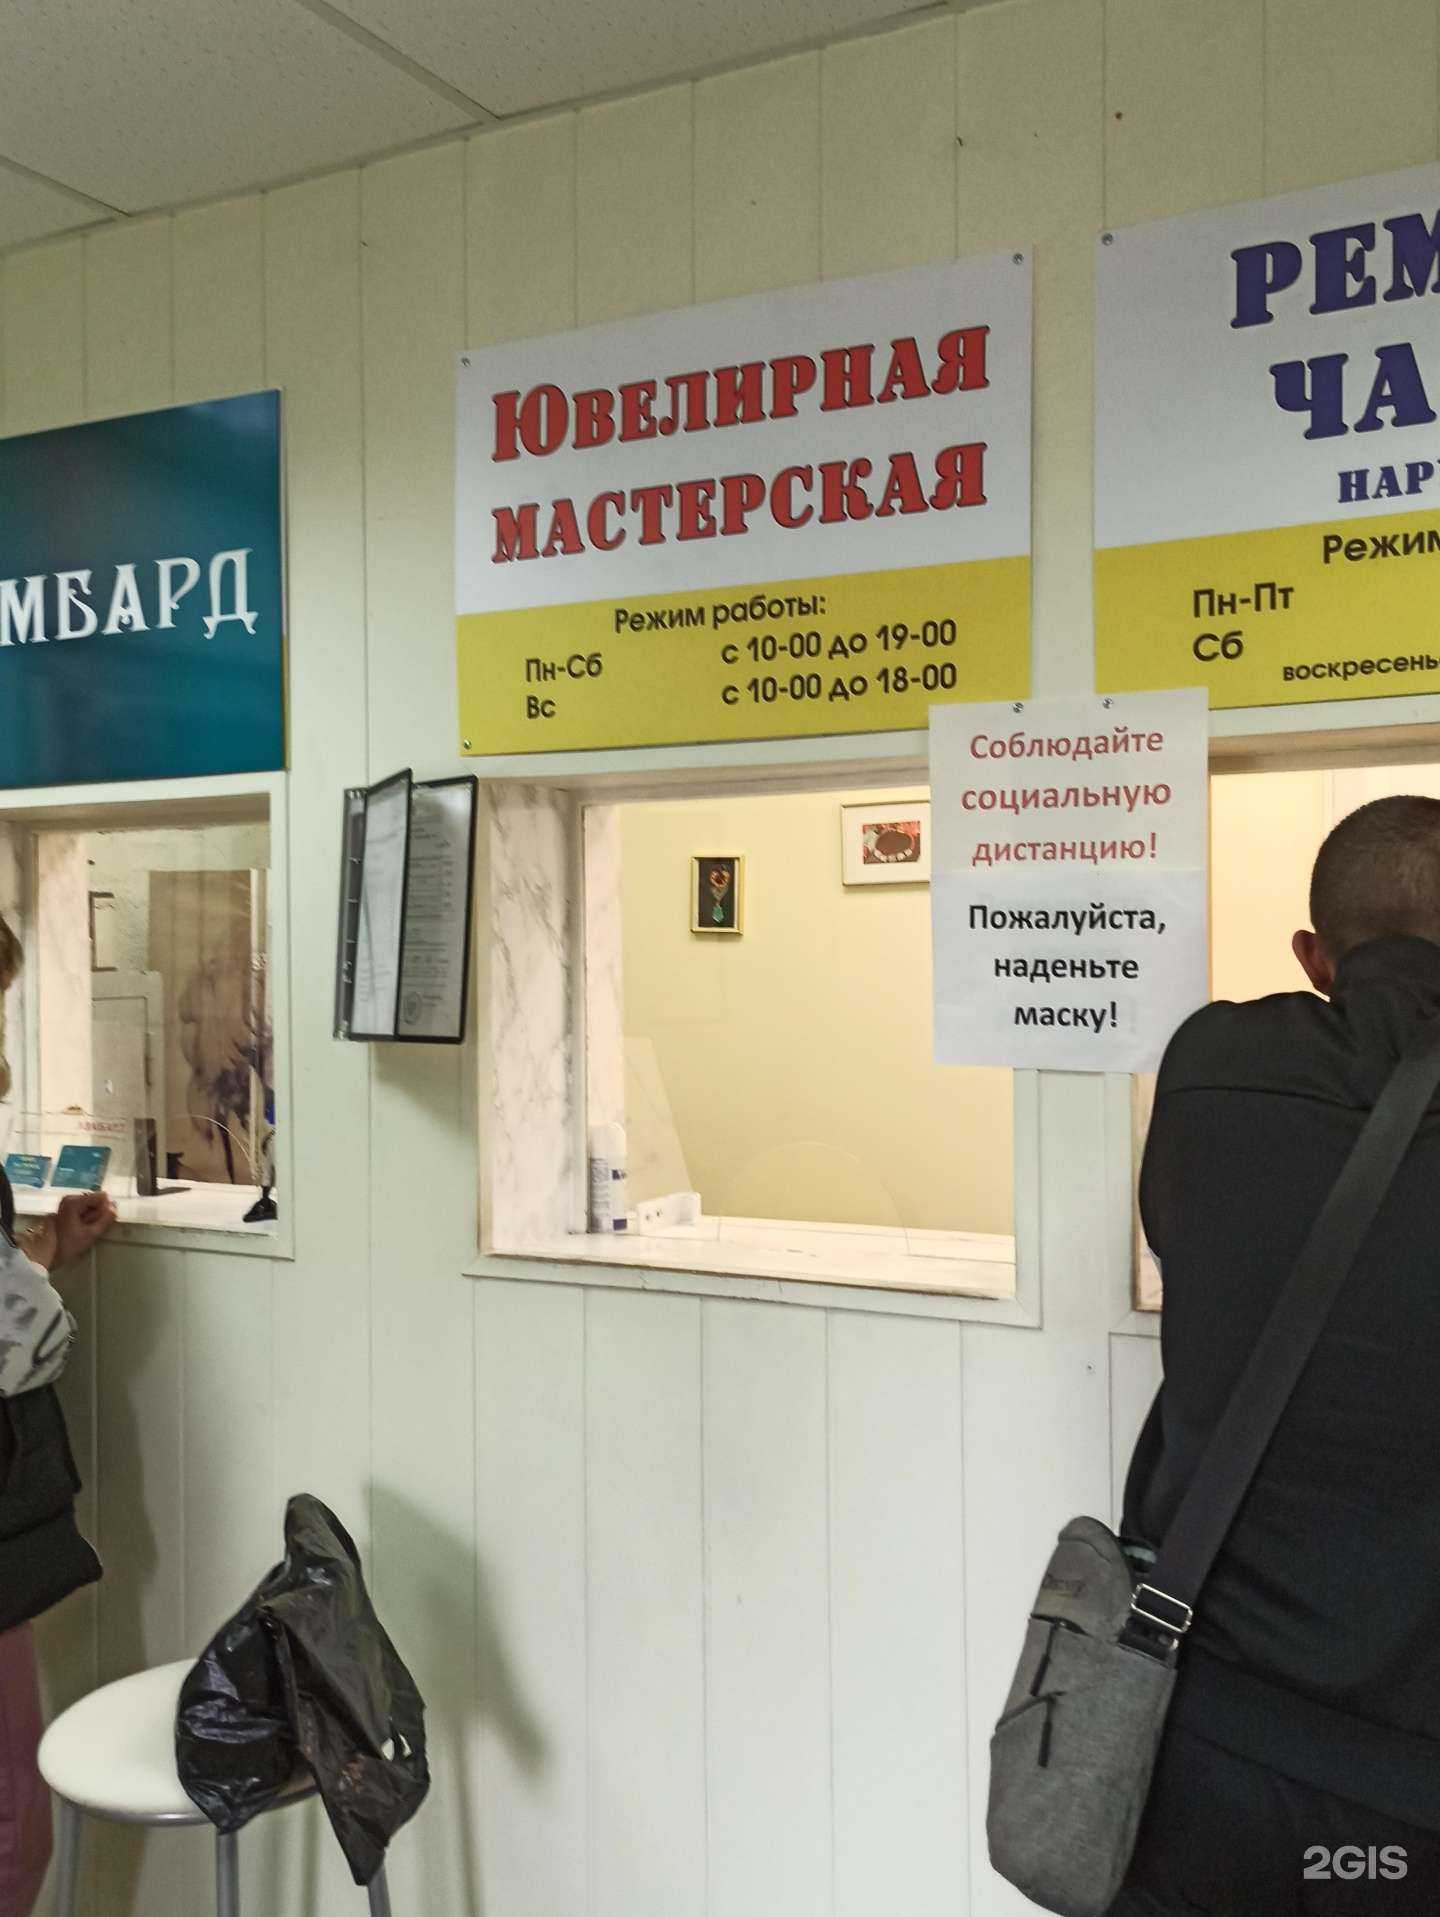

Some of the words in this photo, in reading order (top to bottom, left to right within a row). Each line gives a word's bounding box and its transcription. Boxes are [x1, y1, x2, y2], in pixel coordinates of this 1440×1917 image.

[491, 325, 990, 463] ЮВЕЛИРНАЯ
[1269, 342, 1438, 440] ЧА
[1337, 459, 1440, 504] НАР
[491, 442, 987, 564] МАСТЕРСКАЯ
[0, 548, 259, 647] МБАРД
[614, 606, 706, 634] Режим
[712, 593, 827, 631] работы:
[1193, 582, 1295, 618] Пн-Пт
[525, 653, 604, 683] Пн-Сб
[721, 644, 740, 665] с
[746, 630, 822, 662] 10-00
[827, 632, 869, 661] до
[875, 618, 957, 652] 19-00
[1193, 630, 1245, 662] Сб
[1282, 653, 1440, 683] воскресень
[526, 695, 556, 720] Вс
[721, 685, 740, 706] с
[746, 672, 822, 704] 10-00
[827, 675, 869, 702] до
[875, 661, 957, 694] 18-00
[969, 726, 1164, 761] Соблюдайте
[960, 782, 1173, 816] социальную
[971, 831, 1158, 867] дистанцию!
[968, 901, 1167, 935] Пожалуйста,
[993, 957, 1140, 983] наденьте
[1013, 1000, 1119, 1034] маску!
